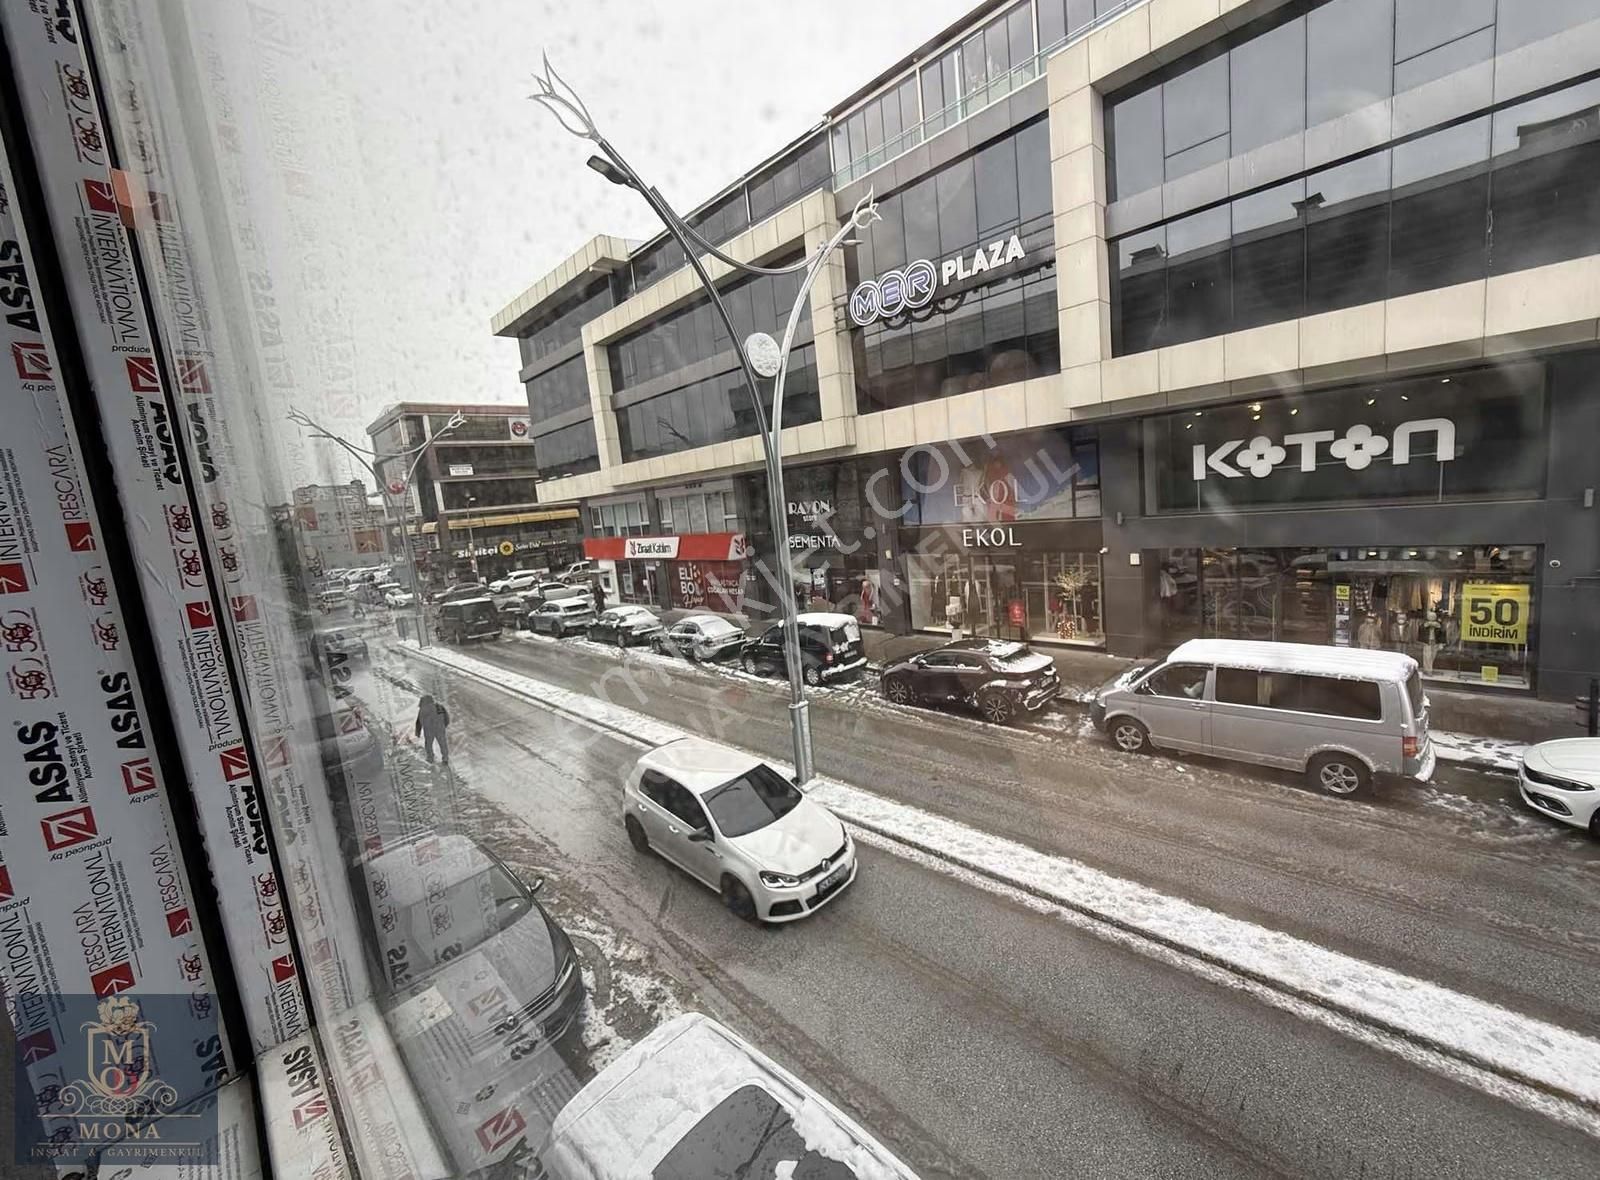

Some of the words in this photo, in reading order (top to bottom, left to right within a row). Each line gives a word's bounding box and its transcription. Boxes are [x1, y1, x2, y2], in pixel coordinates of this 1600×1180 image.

[92, 214, 140, 343] INTERNATIONAL
[852, 263, 935, 322] MER
[942, 235, 1025, 286] PLAZA
[1193, 417, 1456, 480] KOTON
[46, 444, 80, 521] RESCARA
[788, 499, 830, 515] RAYON
[953, 477, 1028, 508] EKOL
[789, 535, 840, 548] SEMENTA
[963, 527, 1023, 548] EKOL
[1469, 624, 1518, 639] İNDİRİM
[1470, 599, 1519, 626] 50
[191, 631, 233, 740] INTERNATIONAL
[85, 850, 130, 963] INTERNATIONAL
[150, 846, 181, 911] RESCARA
[73, 901, 106, 973] RESCARA
[1, 911, 50, 1031] INTERNATIONAL
